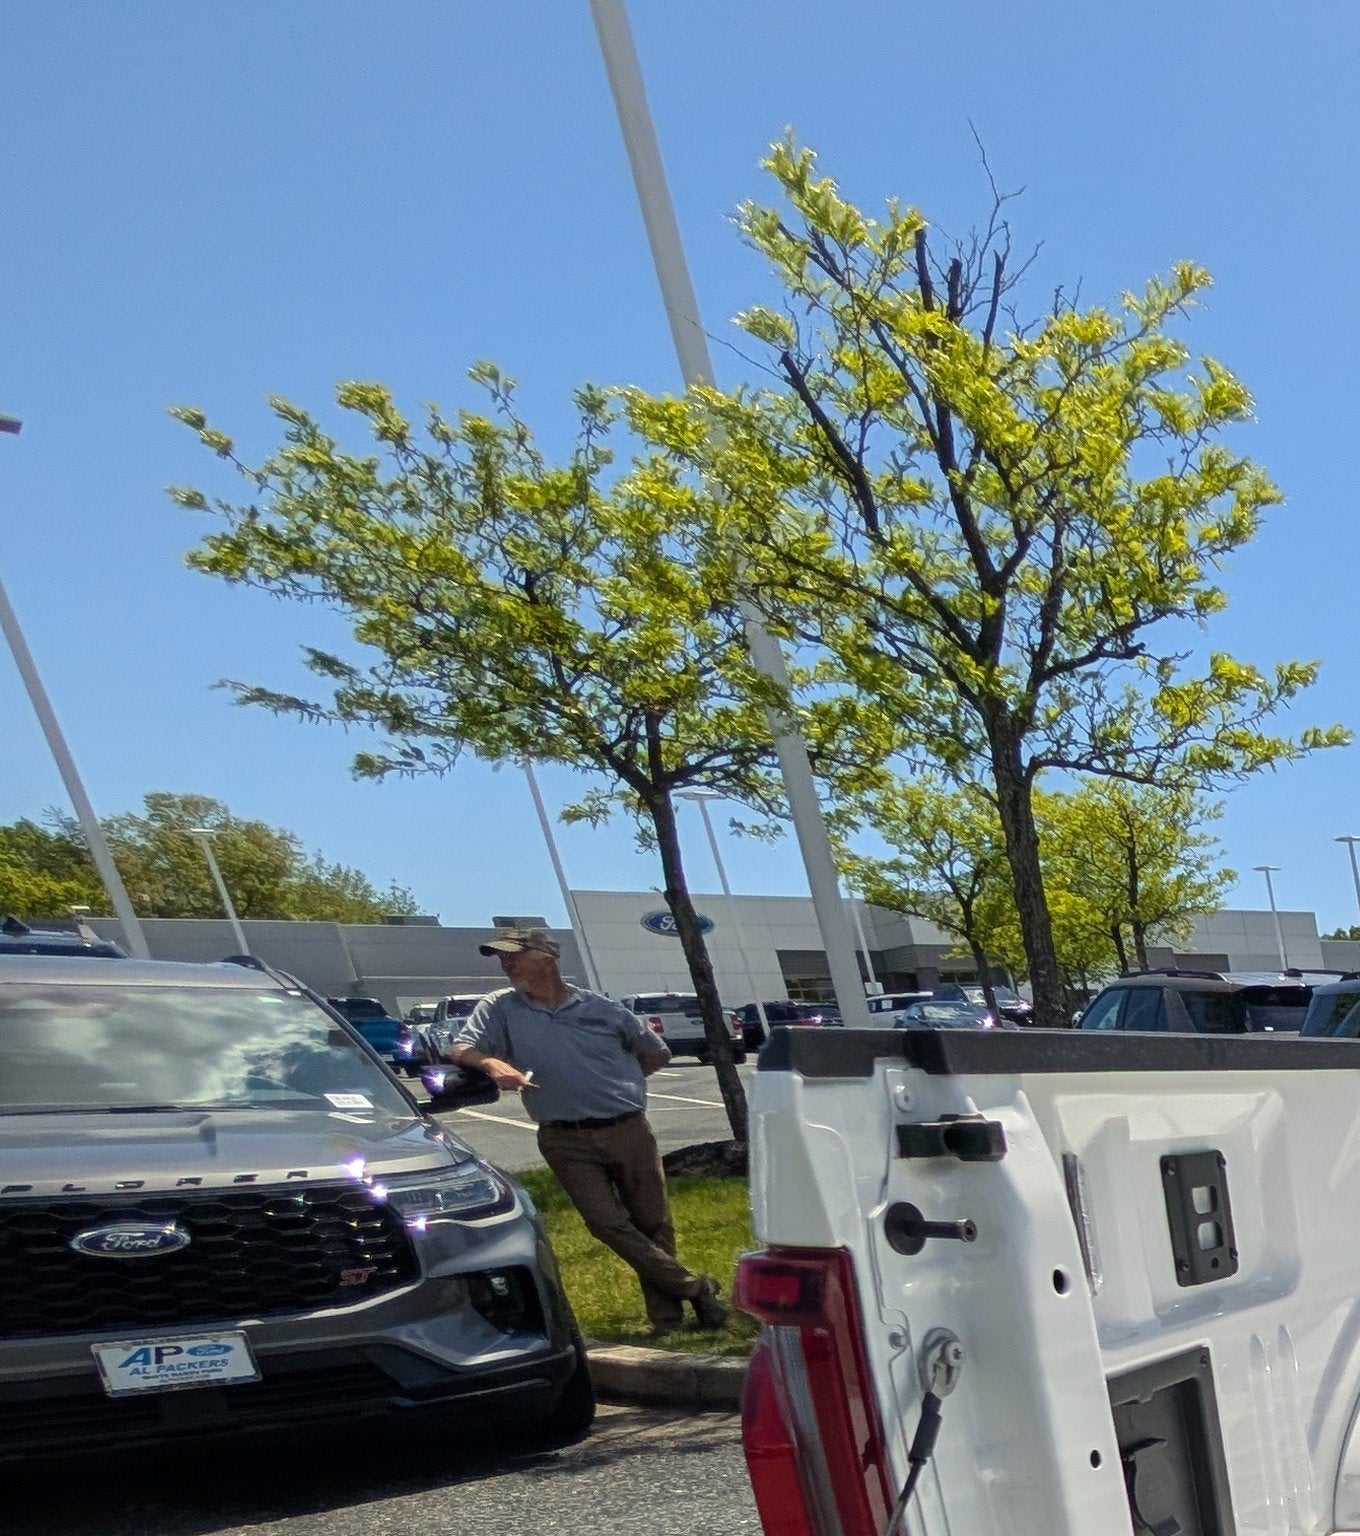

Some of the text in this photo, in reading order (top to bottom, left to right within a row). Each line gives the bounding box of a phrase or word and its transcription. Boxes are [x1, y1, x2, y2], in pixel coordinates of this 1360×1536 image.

[101, 1231, 162, 1251] Ford
[118, 1345, 184, 1369] AP
[129, 1366, 152, 1376] AL
